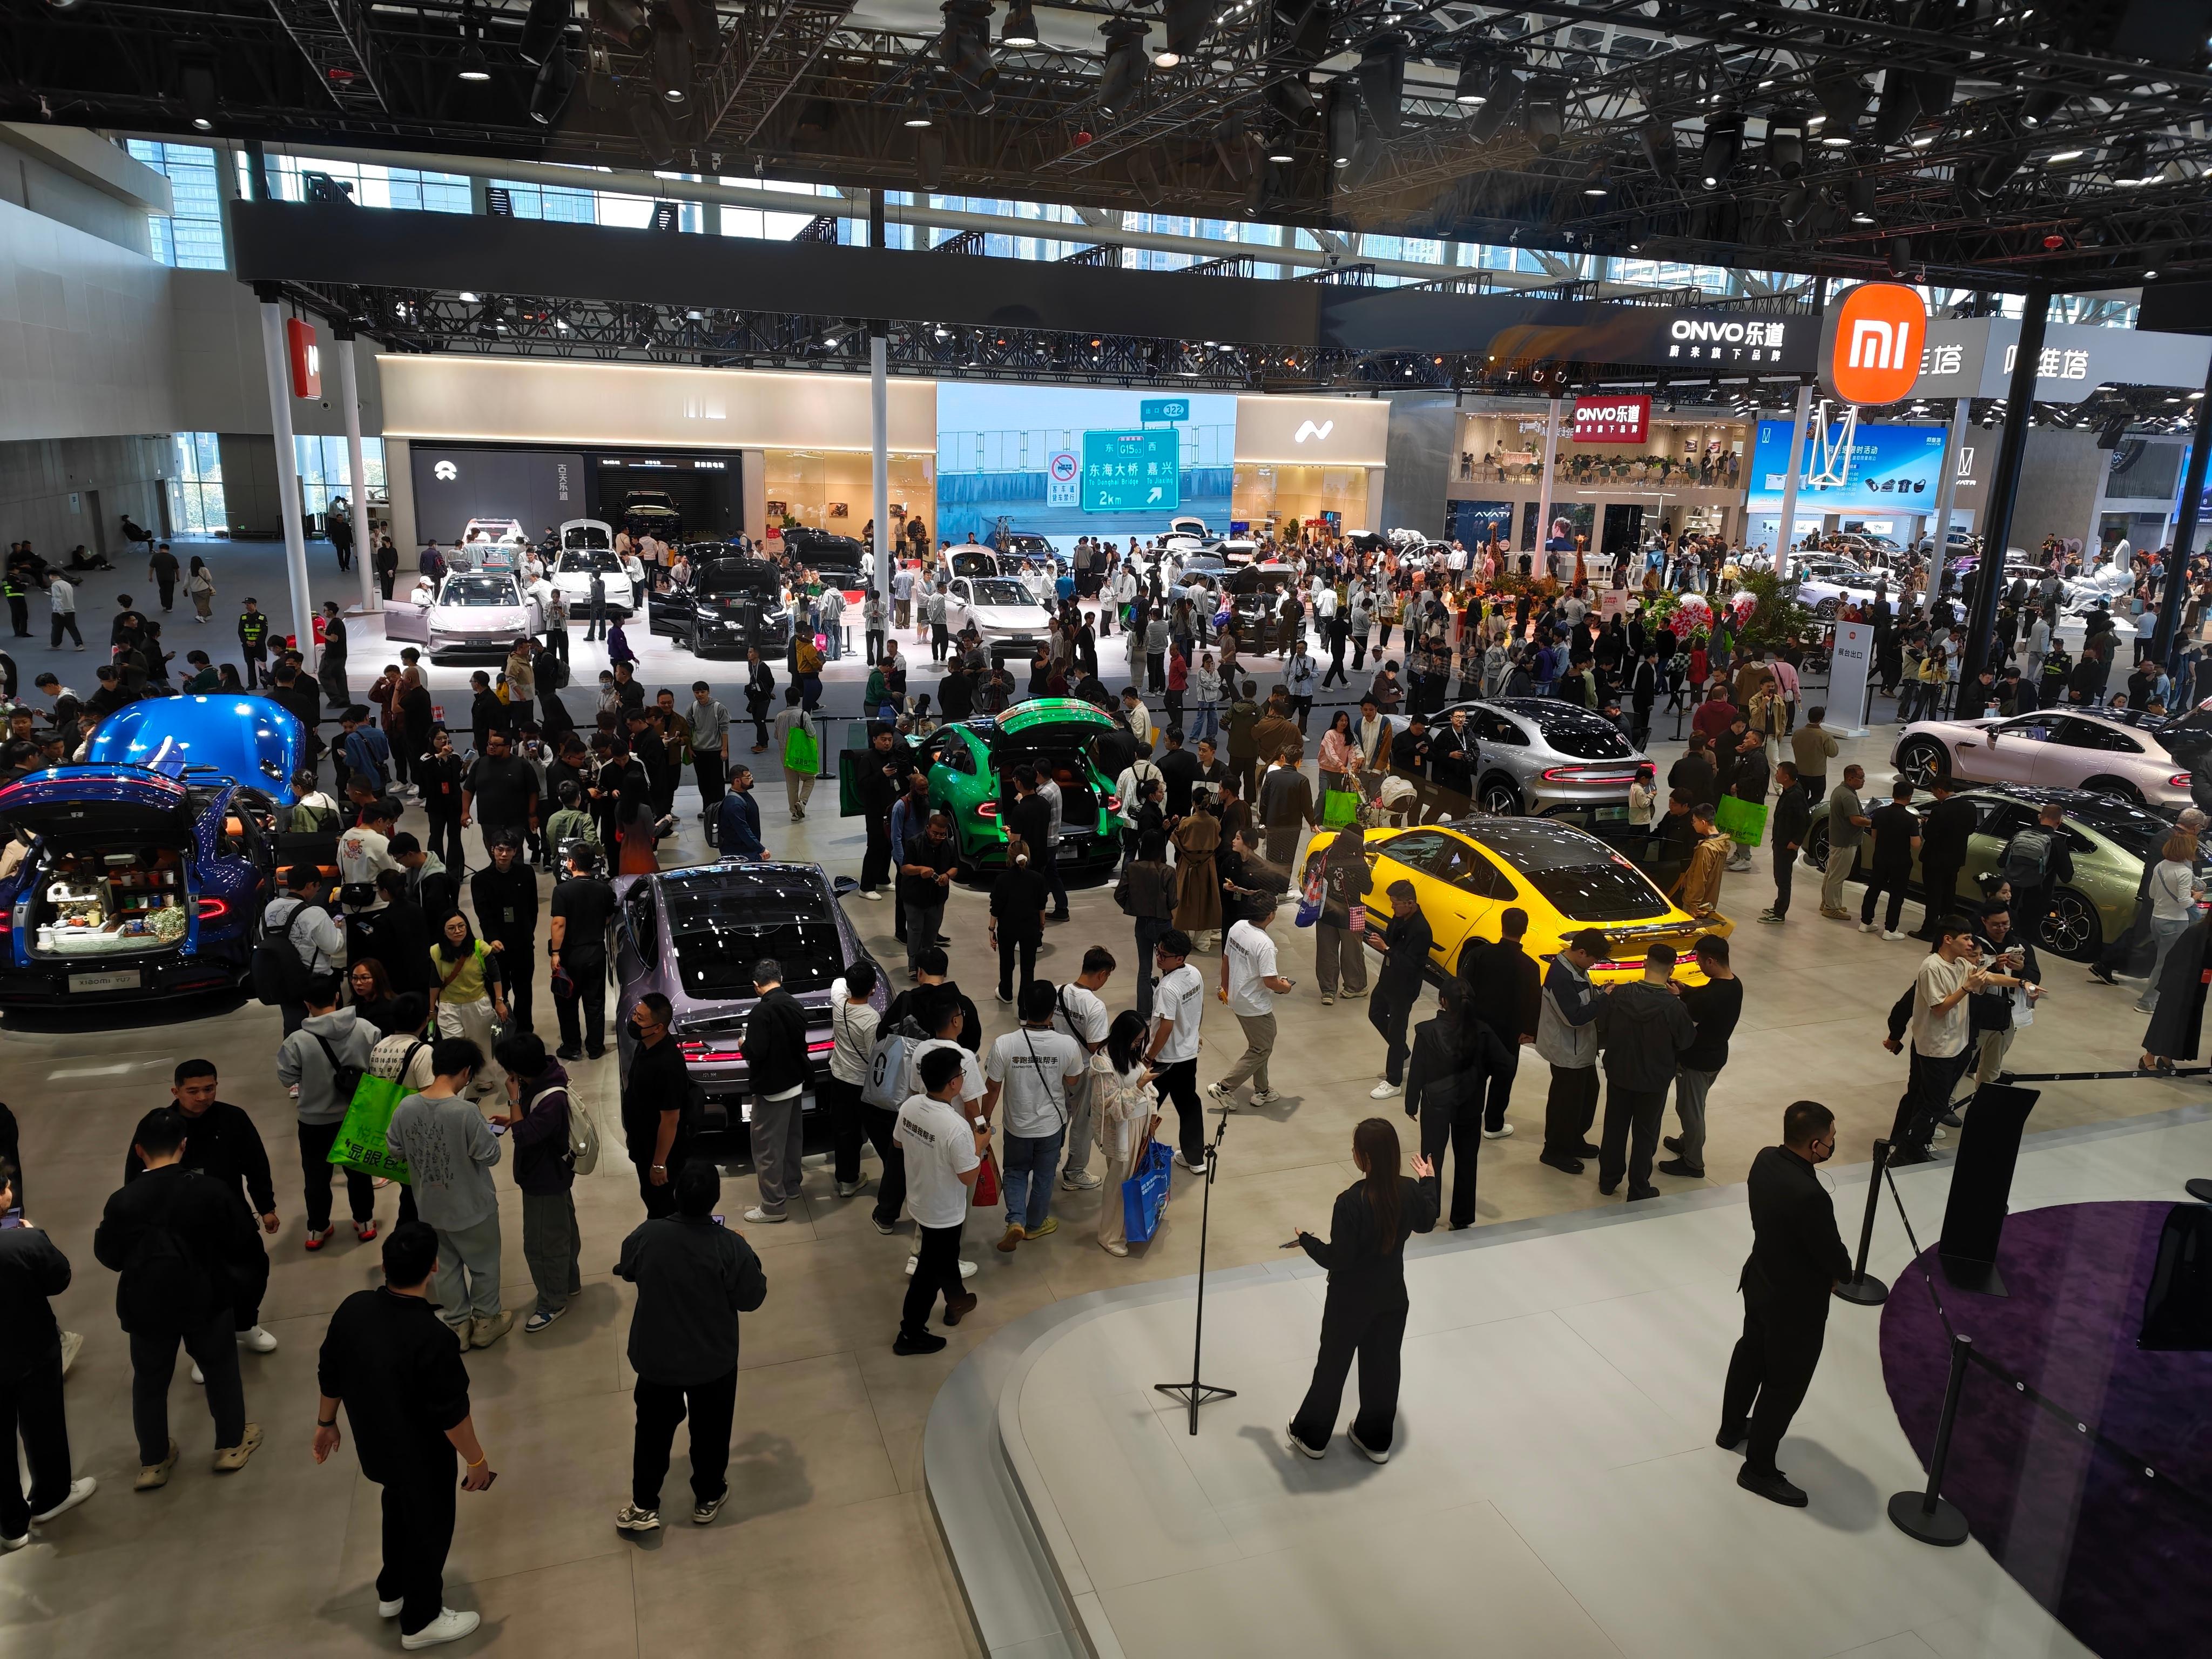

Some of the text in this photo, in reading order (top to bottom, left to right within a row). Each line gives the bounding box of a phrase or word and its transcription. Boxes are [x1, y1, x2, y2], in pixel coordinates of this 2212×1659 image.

[1669, 345, 1781, 362] 蔚来旗下品牌
[1166, 406, 1182, 414] 322
[1105, 443, 1114, 453] 东
[1148, 442, 1157, 451] 西
[1089, 461, 1173, 477] 东海大桥 嘉兴
[557, 464, 568, 501] 古天乐道
[1155, 477, 1173, 485] Jiaxing
[1099, 490, 1122, 505] 2km
[1838, 648, 1863, 659] 展台出口
